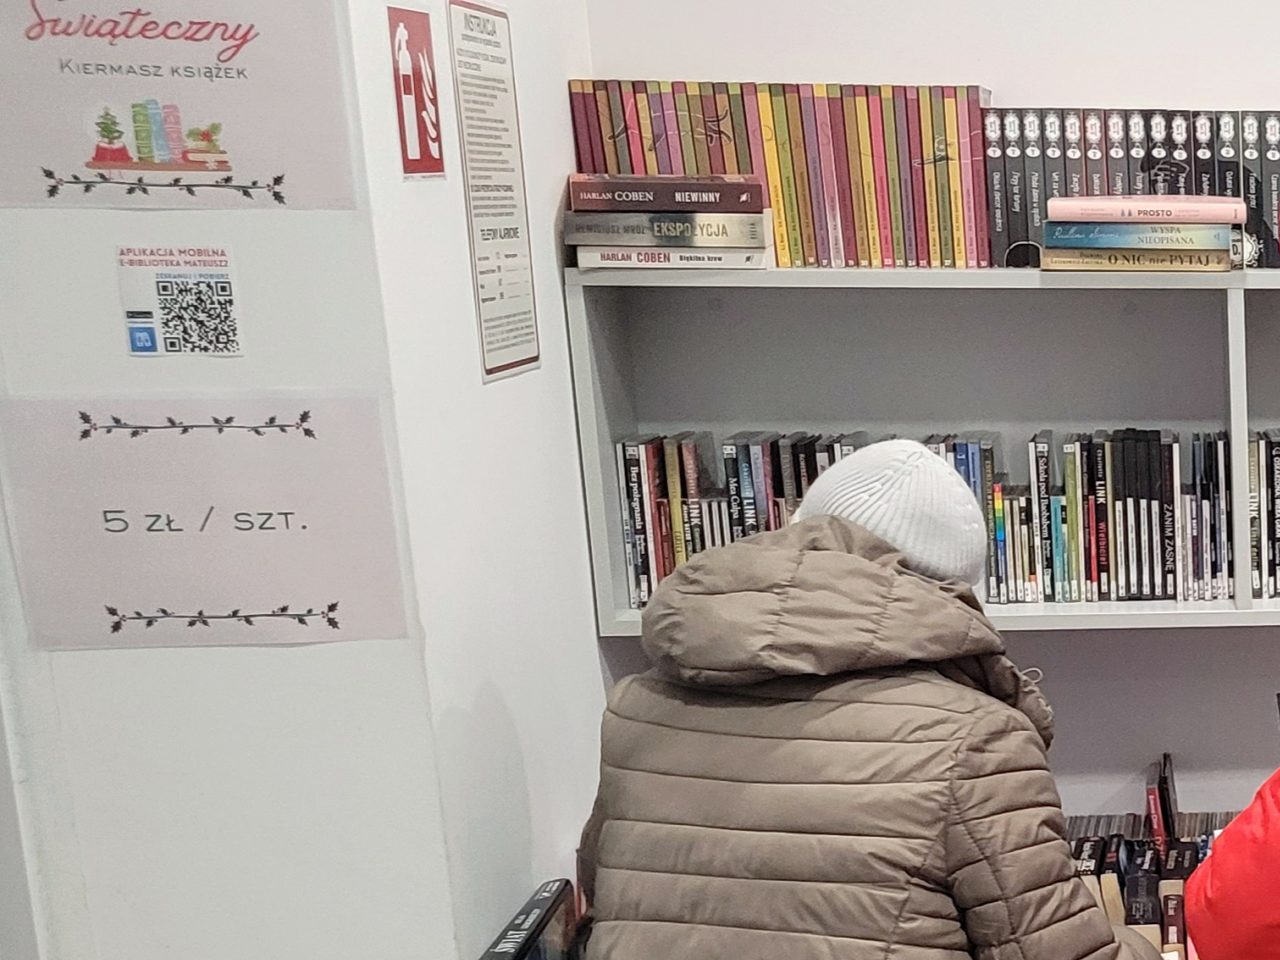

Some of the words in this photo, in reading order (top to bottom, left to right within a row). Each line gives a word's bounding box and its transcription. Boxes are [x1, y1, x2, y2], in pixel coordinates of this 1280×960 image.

[615, 192, 654, 201] COBEN
[675, 192, 720, 203] NIEWINNY
[1137, 209, 1172, 217] PROSTO
[120, 248, 175, 257] APLIKACJA
[178, 249, 226, 257] MOBILNA
[600, 253, 632, 262] HARLAN
[636, 252, 671, 263] COBEN
[1121, 254, 1145, 265] NIC
[630, 466, 638, 481] Bez
[729, 478, 738, 494] Mea
[1038, 483, 1048, 497] pod
[1095, 481, 1106, 504] LINK
[688, 498, 701, 526] LINK
[730, 495, 740, 519] Culpa
[743, 499, 757, 525] LINK
[1249, 493, 1259, 518] LINK
[103, 509, 129, 532] 5
[145, 512, 183, 532] ZŁ
[200, 506, 214, 532] /
[234, 511, 308, 531] SZT.
[1163, 504, 1173, 537] ZANIM
